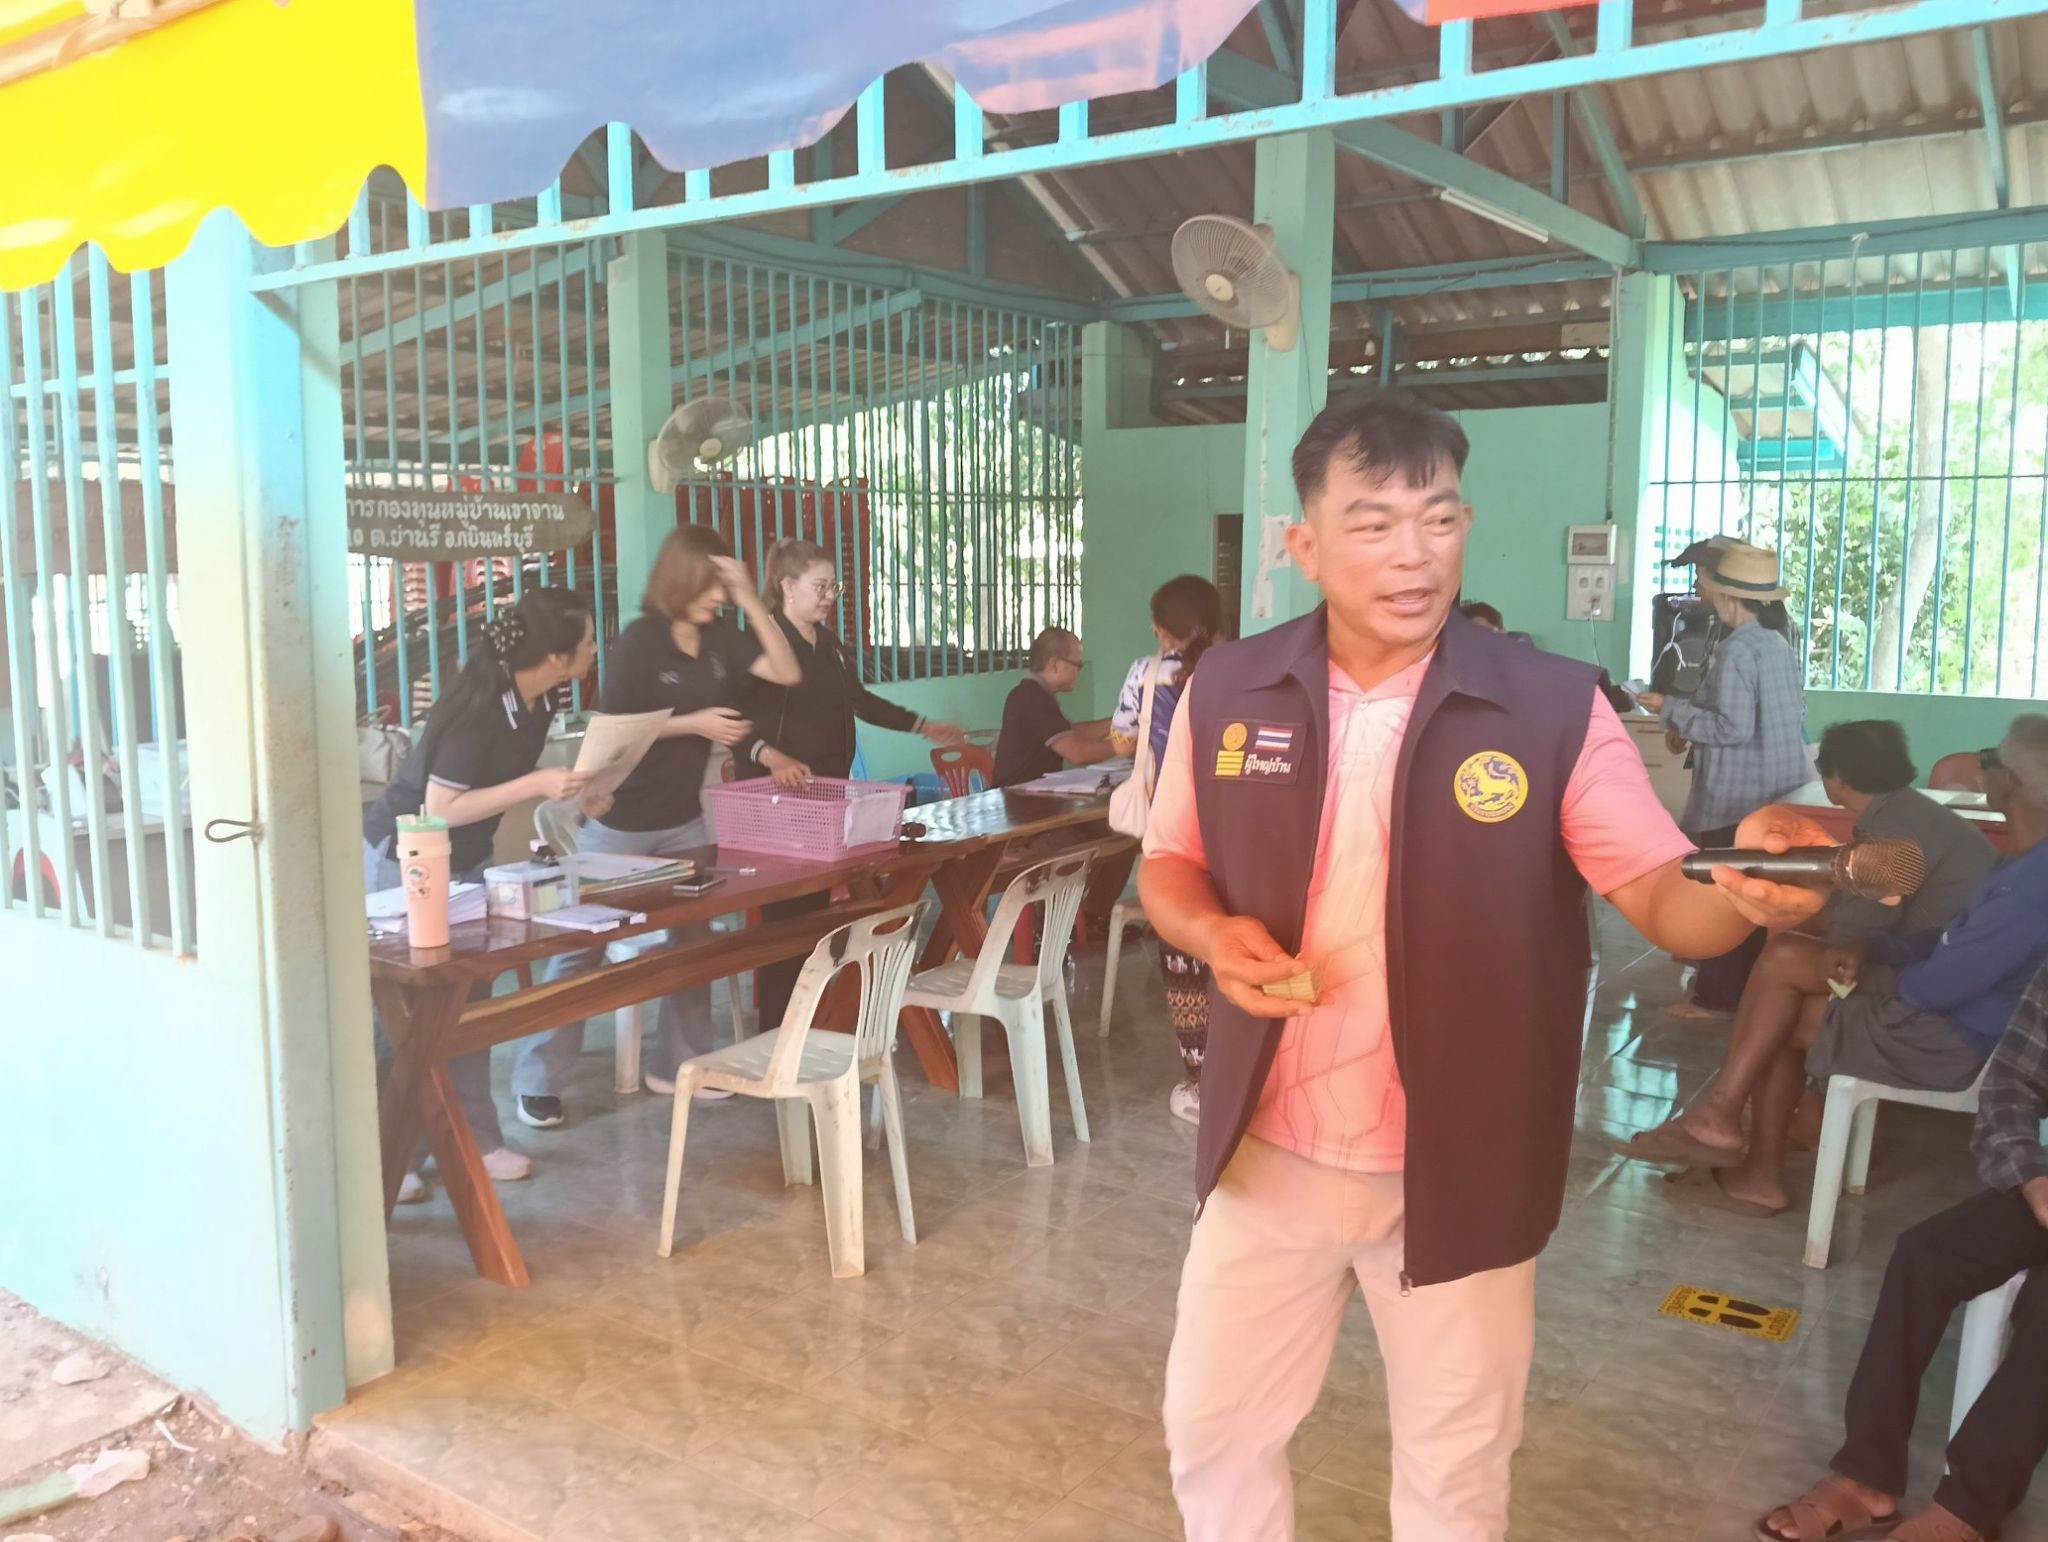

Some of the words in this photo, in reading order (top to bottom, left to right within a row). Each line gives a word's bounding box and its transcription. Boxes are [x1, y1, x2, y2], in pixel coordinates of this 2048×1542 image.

[370, 523, 441, 548] ต.ย่านรี
[444, 522, 535, 554] อ.กบินทร์บุรี
[1244, 753, 1292, 776] ผู้ใหญ่บ้าน
